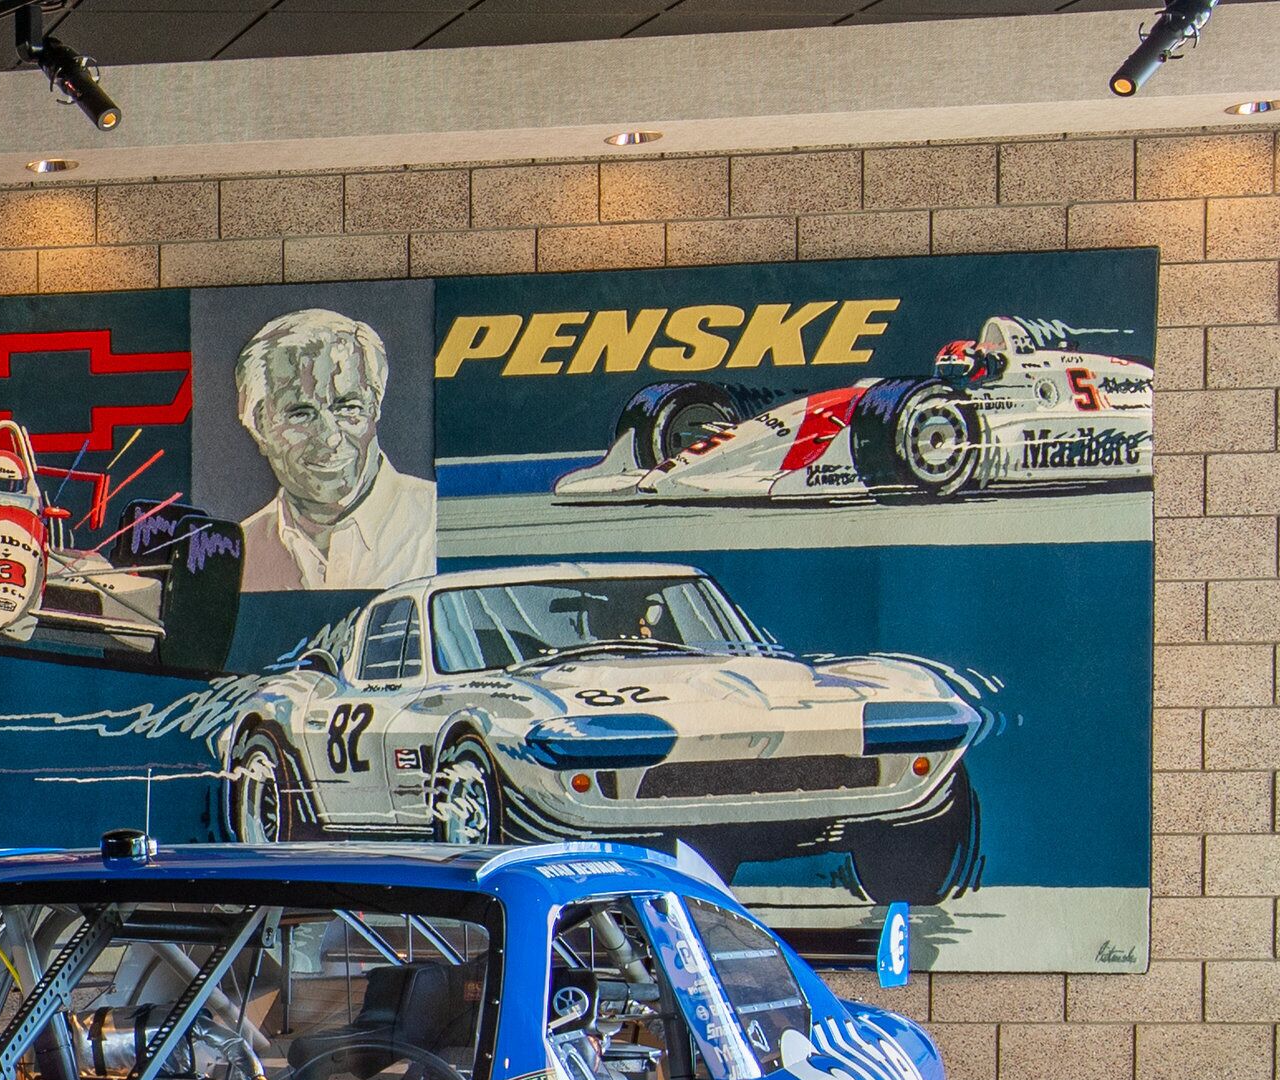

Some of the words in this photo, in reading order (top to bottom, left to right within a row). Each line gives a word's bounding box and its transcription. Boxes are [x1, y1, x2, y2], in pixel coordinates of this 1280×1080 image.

[435, 299, 902, 377] PENSKE
[1066, 368, 1100, 411] 5
[575, 687, 669, 707] 82
[327, 703, 374, 774] 82
[535, 864, 575, 878] RYAN
[569, 860, 626, 876] NEWMAN
